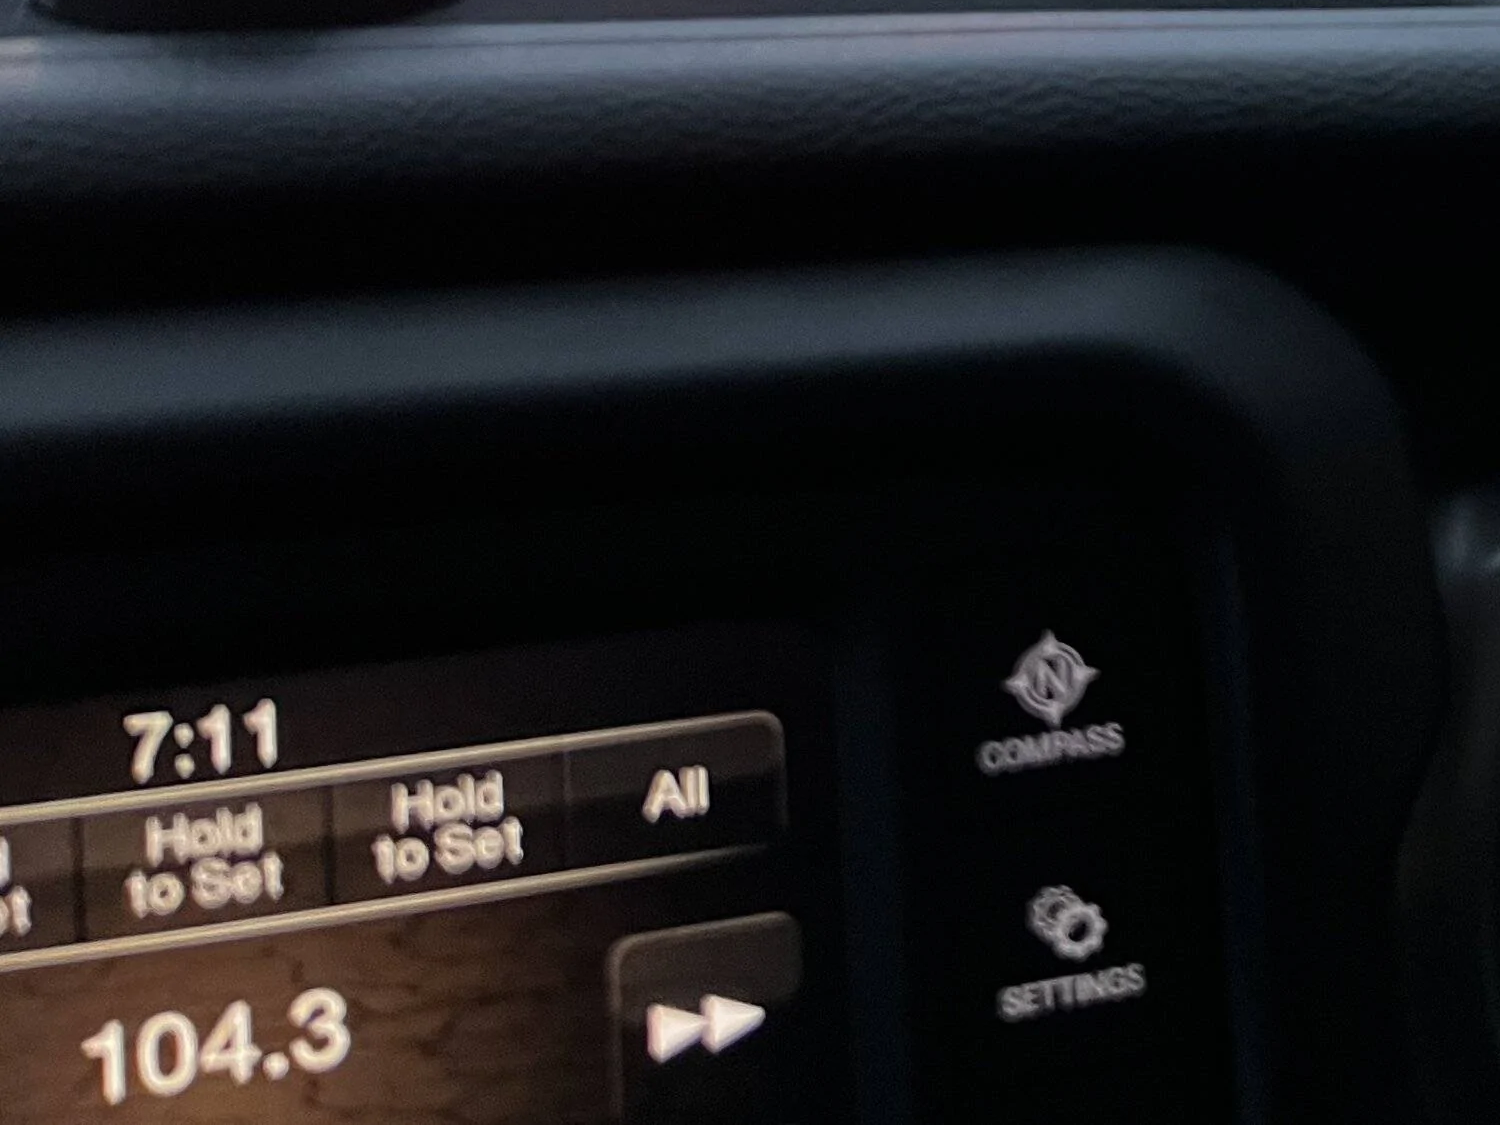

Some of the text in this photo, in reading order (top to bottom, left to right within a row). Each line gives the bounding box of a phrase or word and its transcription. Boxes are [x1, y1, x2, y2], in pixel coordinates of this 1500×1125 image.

[122, 697, 278, 785] 7:11
[978, 722, 1126, 775] COMPASS
[391, 769, 504, 835] Hold
[642, 764, 710, 824] All
[145, 801, 263, 868] Hold
[371, 815, 524, 885] to Set
[124, 850, 284, 919] to Set
[998, 962, 1146, 1021] SETTINGS
[79, 986, 351, 1106] 104.3
